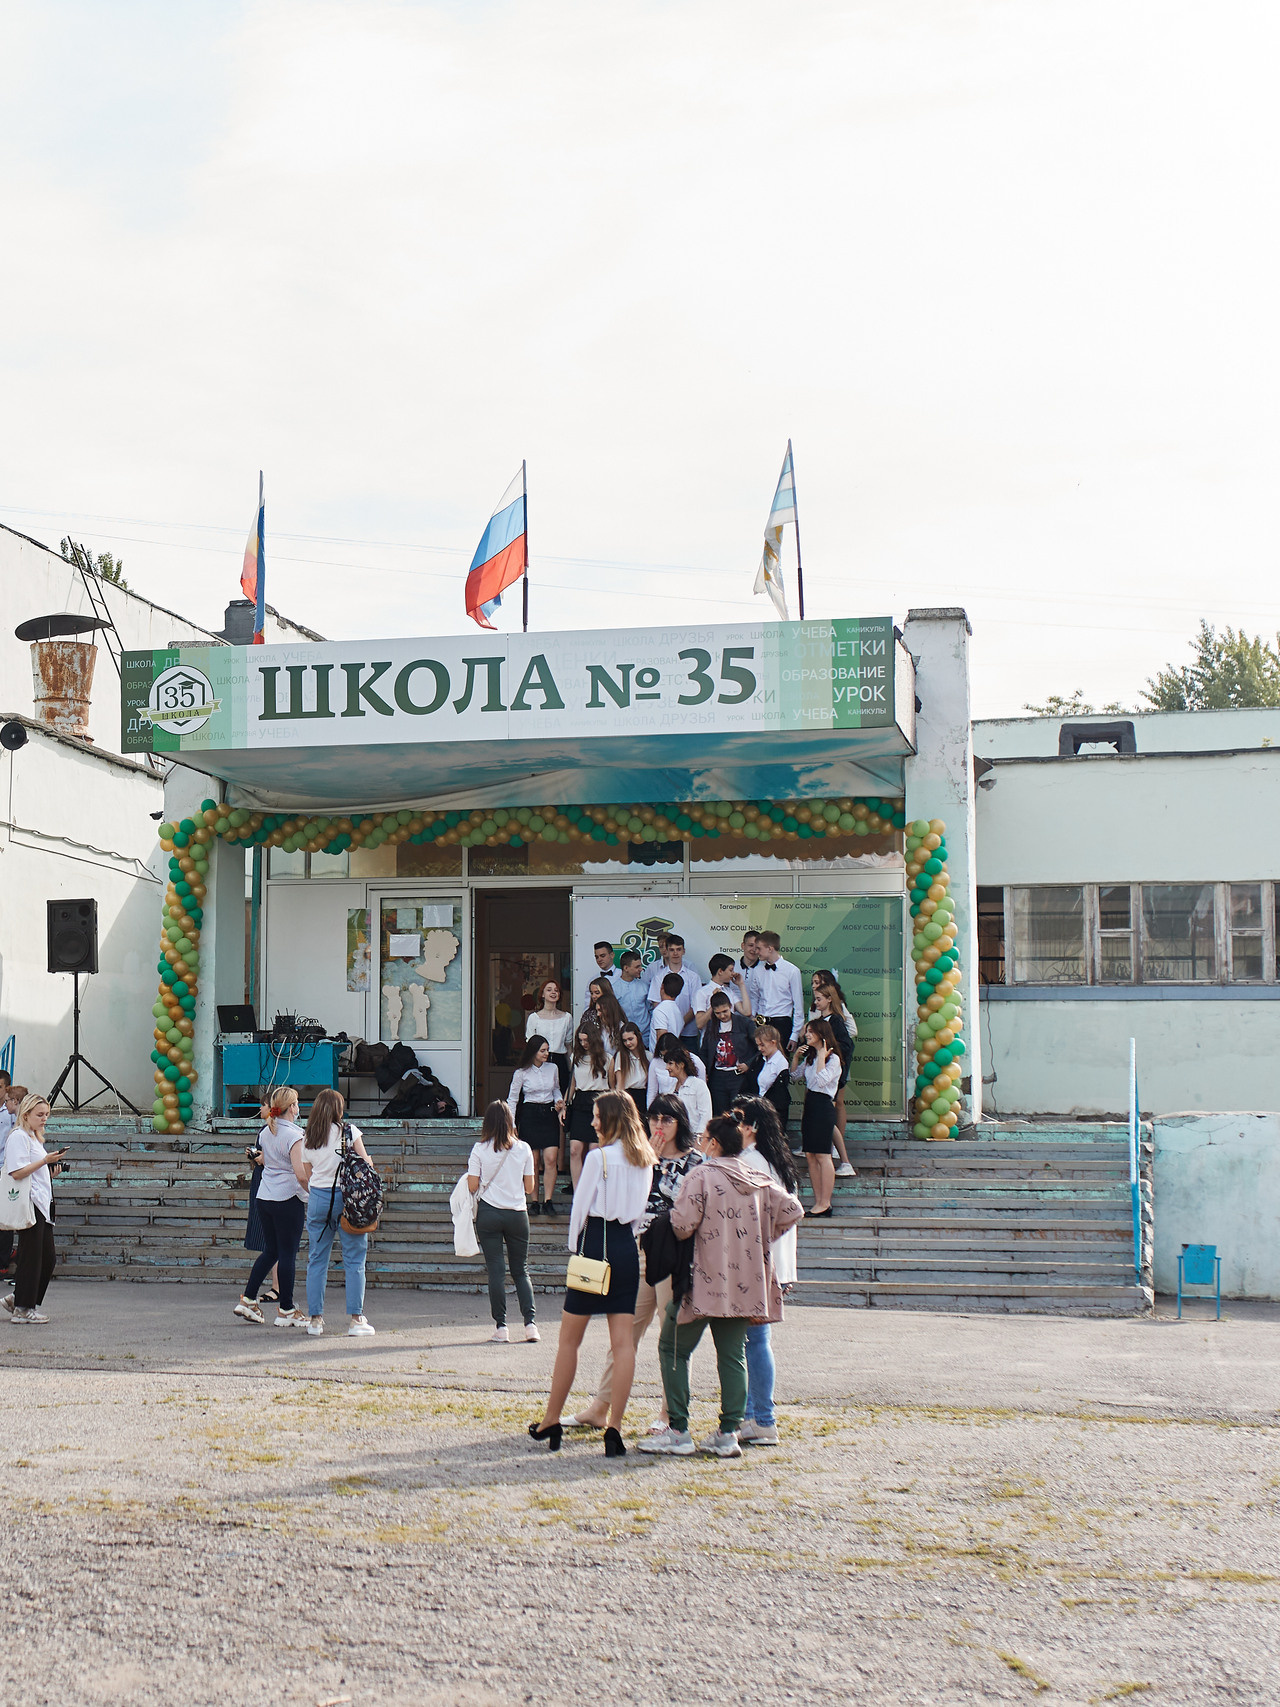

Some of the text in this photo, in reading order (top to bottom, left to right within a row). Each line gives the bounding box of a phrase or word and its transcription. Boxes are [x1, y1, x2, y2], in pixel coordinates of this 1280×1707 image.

[613, 635, 655, 647] ШКОЛА
[658, 631, 715, 647] ДРУЗЬЯ
[726, 633, 744, 641] УРОК
[750, 630, 785, 640] ШКОЛА
[792, 626, 837, 639] УЧЕБА
[846, 626, 885, 634] КАНИКУЛЫ
[793, 640, 886, 659] ОТМЕТКИ
[126, 659, 157, 669] ШКОЛА
[245, 654, 277, 664] ШКОЛА
[216, 675, 250, 685] ШКОЛА
[781, 665, 886, 682] ОБРАЗОВАНИЕ
[257, 646, 757, 720] ШКОЛА № 35
[164, 685, 195, 709] 35
[833, 685, 886, 703] УРОК
[126, 699, 146, 707] УРОК
[162, 708, 201, 720] ШКОЛА
[614, 715, 656, 727] ШКОЛА
[659, 711, 716, 728] ДРУЗЬЯ
[751, 711, 786, 721] ШКОЛА
[792, 707, 838, 721] УЧЕБА
[847, 707, 887, 716] КАНИКУЛЫ
[192, 732, 226, 742] ШКОЛА
[719, 903, 748, 911] Таганрог
